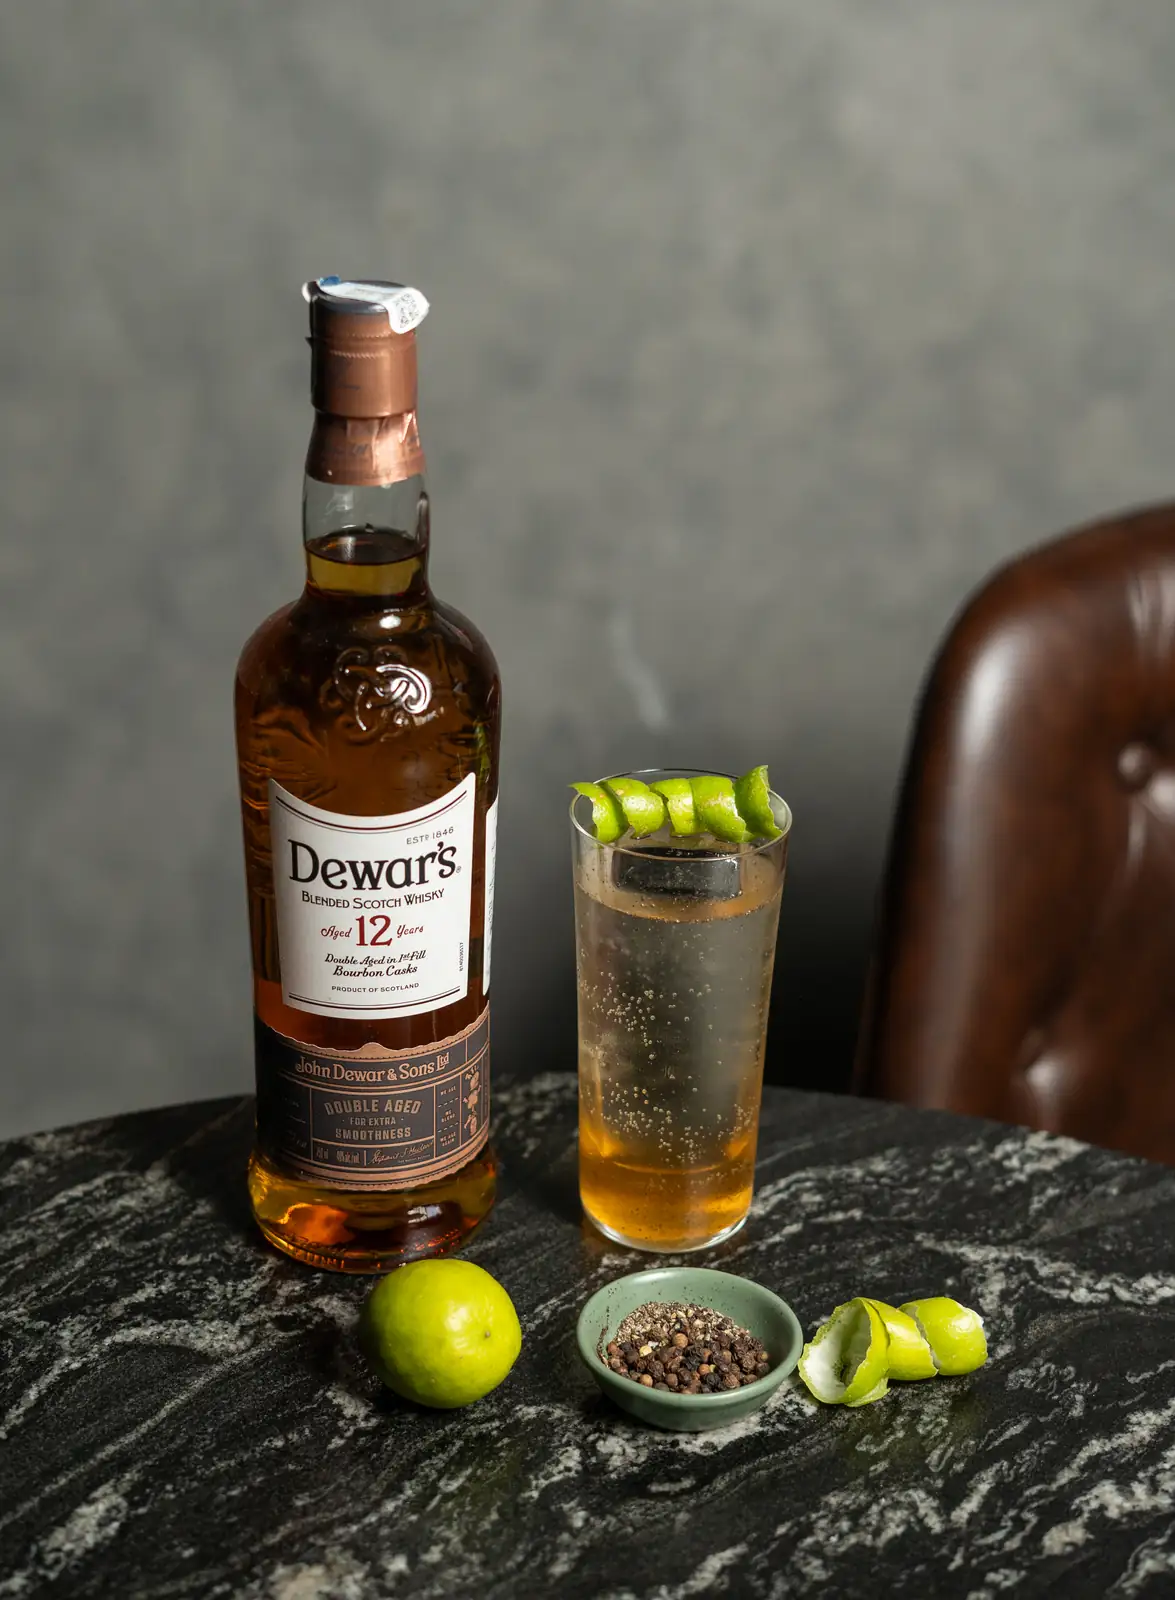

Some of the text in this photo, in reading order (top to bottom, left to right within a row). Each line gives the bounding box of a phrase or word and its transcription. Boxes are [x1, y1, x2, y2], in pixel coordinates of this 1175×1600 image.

[432, 826, 454, 839] 1846
[287, 838, 457, 890] Dewar's
[301, 888, 445, 909] BLENDED SCOTCH WHISKY
[320, 914, 424, 947] Aged 12 Years
[324, 953, 358, 965] Double
[360, 955, 386, 967] Aged
[386, 956, 398, 964] in
[332, 963, 418, 977] Bourbon Casks
[331, 985, 366, 993] PRODUCT
[380, 982, 420, 993] SCOTLAND
[295, 1052, 450, 1082] John Dewar & Sons Ltd
[324, 1099, 422, 1116] DOUBLE AGED
[350, 1116, 397, 1126] FOR EXTRA
[335, 1126, 411, 1141] SMOOTHNESS
